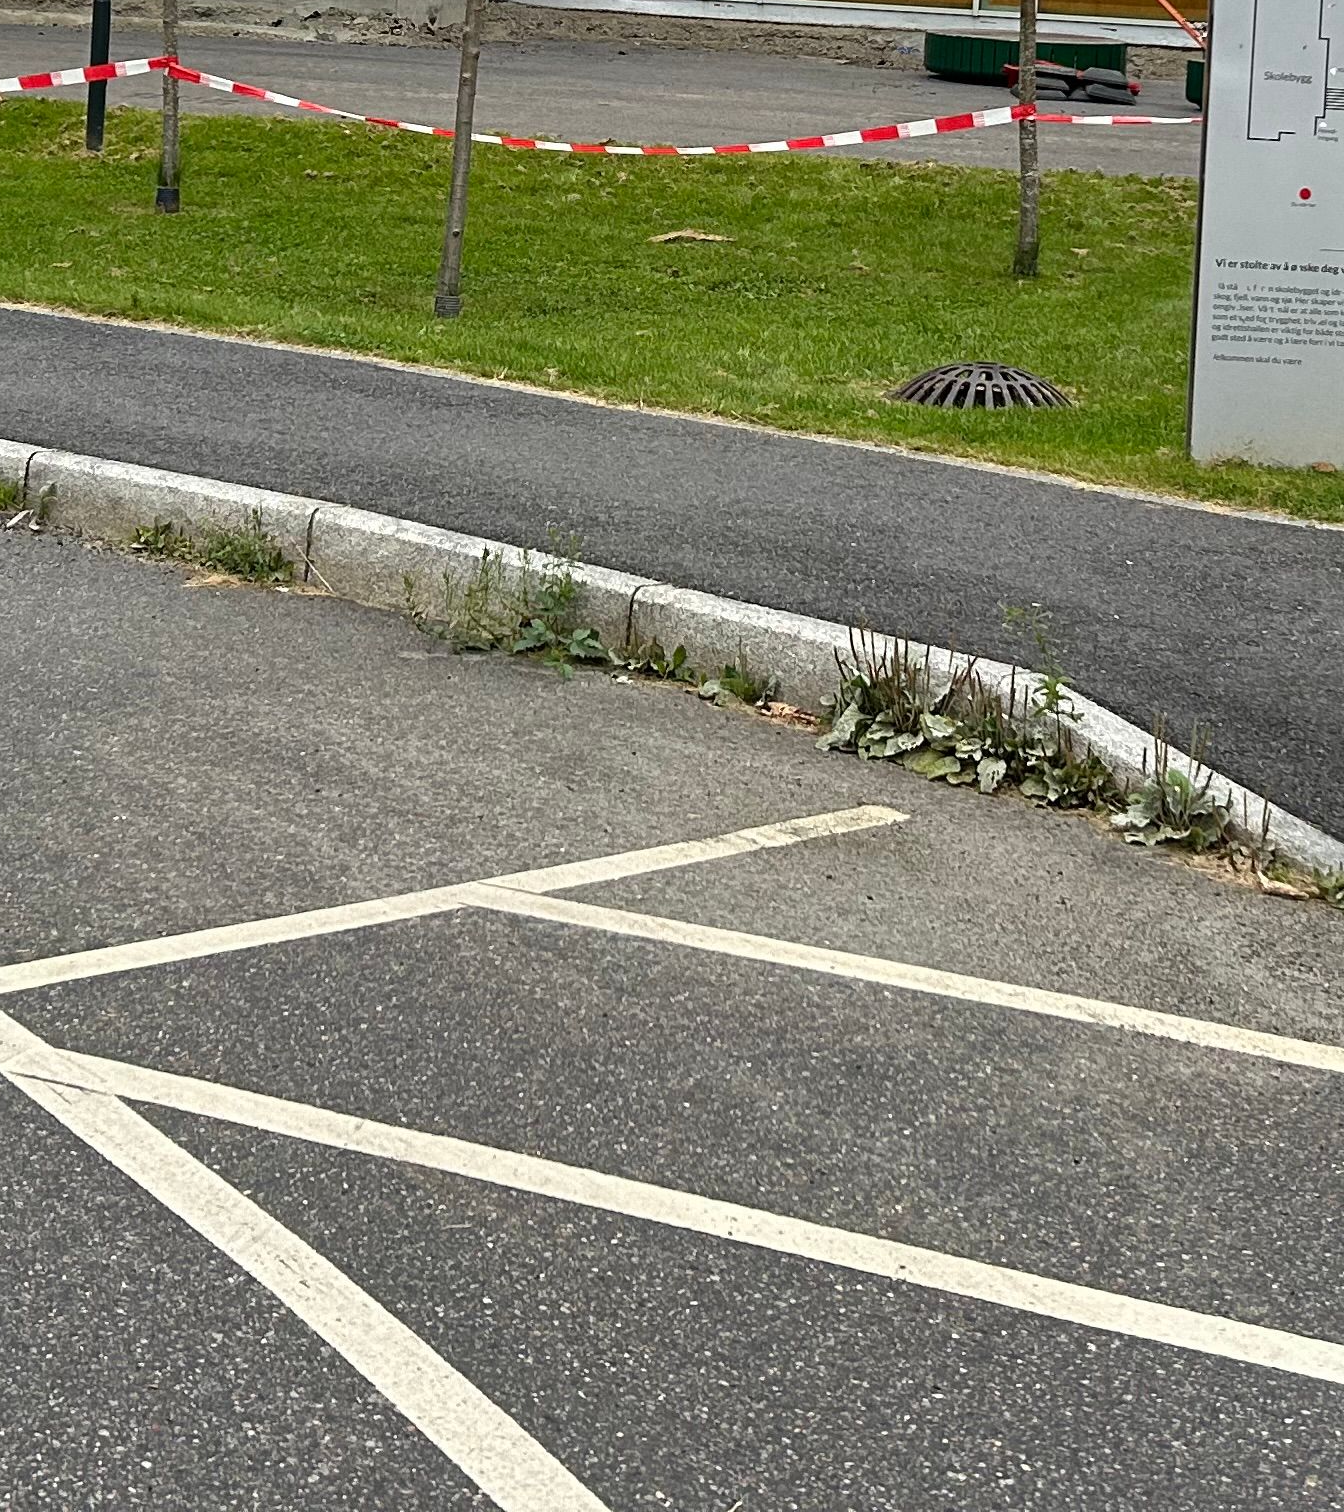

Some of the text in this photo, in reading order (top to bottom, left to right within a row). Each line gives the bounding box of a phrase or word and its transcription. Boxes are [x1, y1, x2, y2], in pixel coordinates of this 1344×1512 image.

[1263, 71, 1313, 85] Skolebygg
[1216, 258, 1227, 268] Vi
[1227, 261, 1238, 269] er
[1240, 260, 1268, 270] stolte
[1270, 263, 1281, 271] av
[1321, 264, 1339, 275] deg
